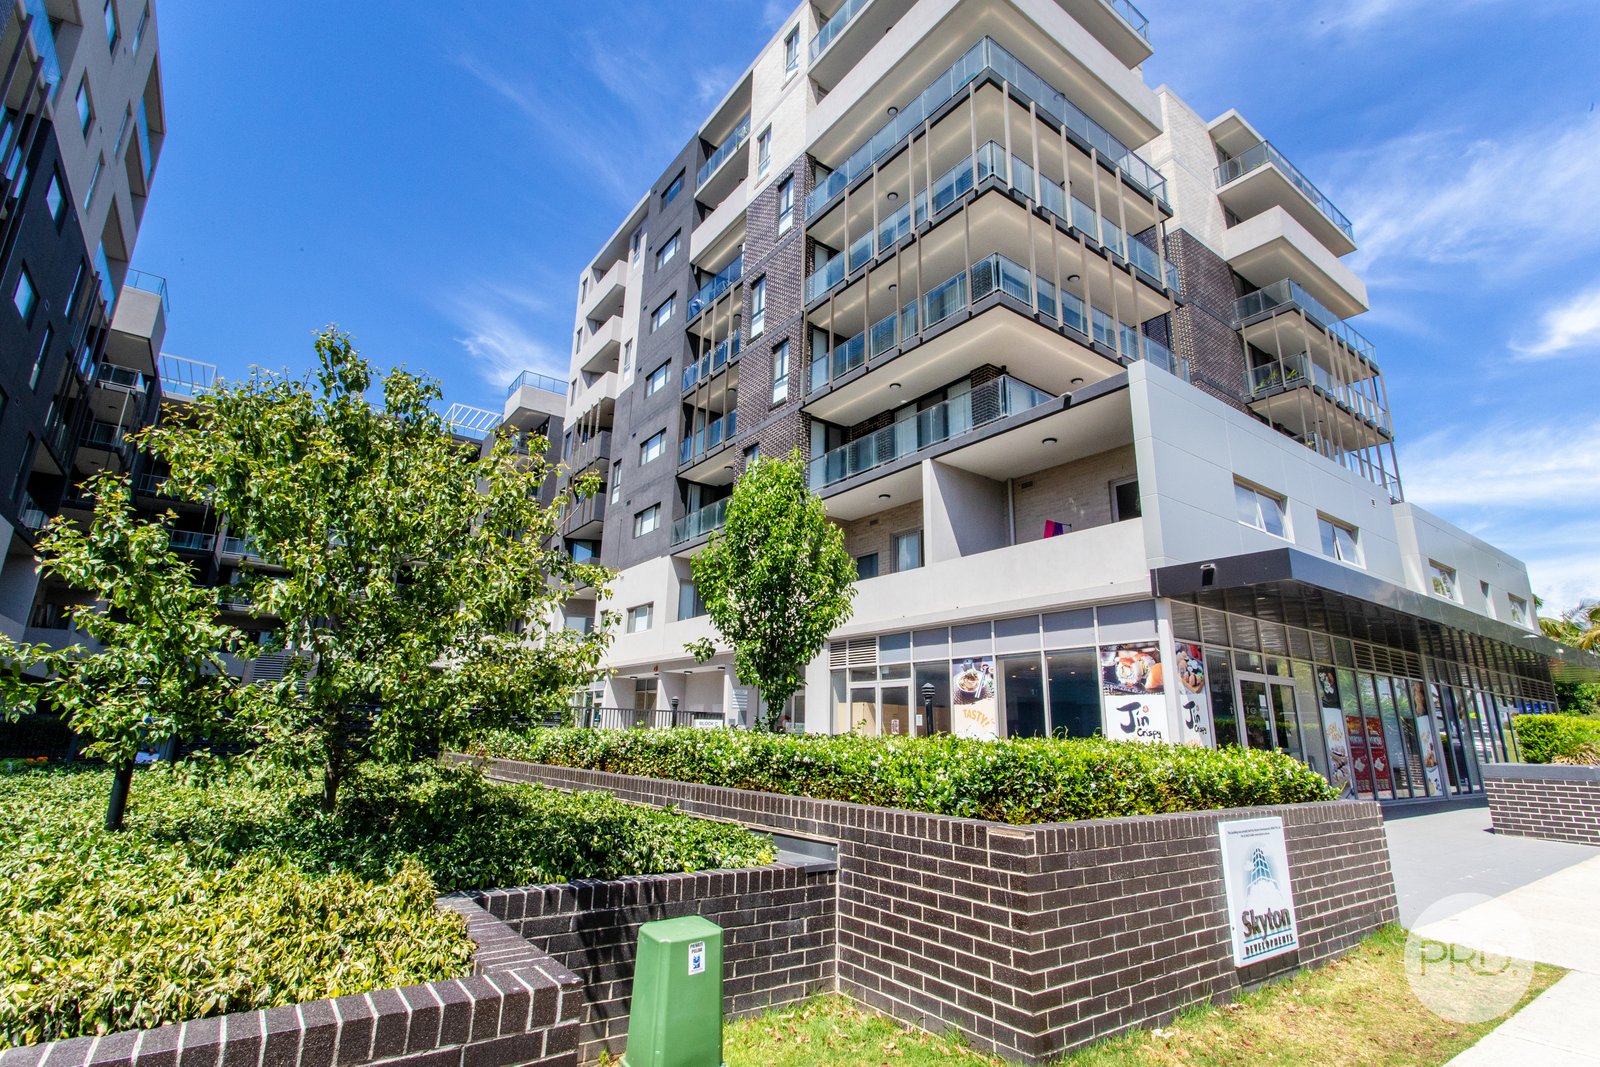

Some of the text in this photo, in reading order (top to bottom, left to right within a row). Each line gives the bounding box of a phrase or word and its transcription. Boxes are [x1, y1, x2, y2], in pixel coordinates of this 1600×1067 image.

[1116, 701, 1149, 734] Jin
[1183, 701, 1200, 729] Jin
[1136, 727, 1162, 740] Crispy
[1241, 907, 1291, 940] Skyton
[1245, 934, 1294, 956] DEVELOPMENTS
